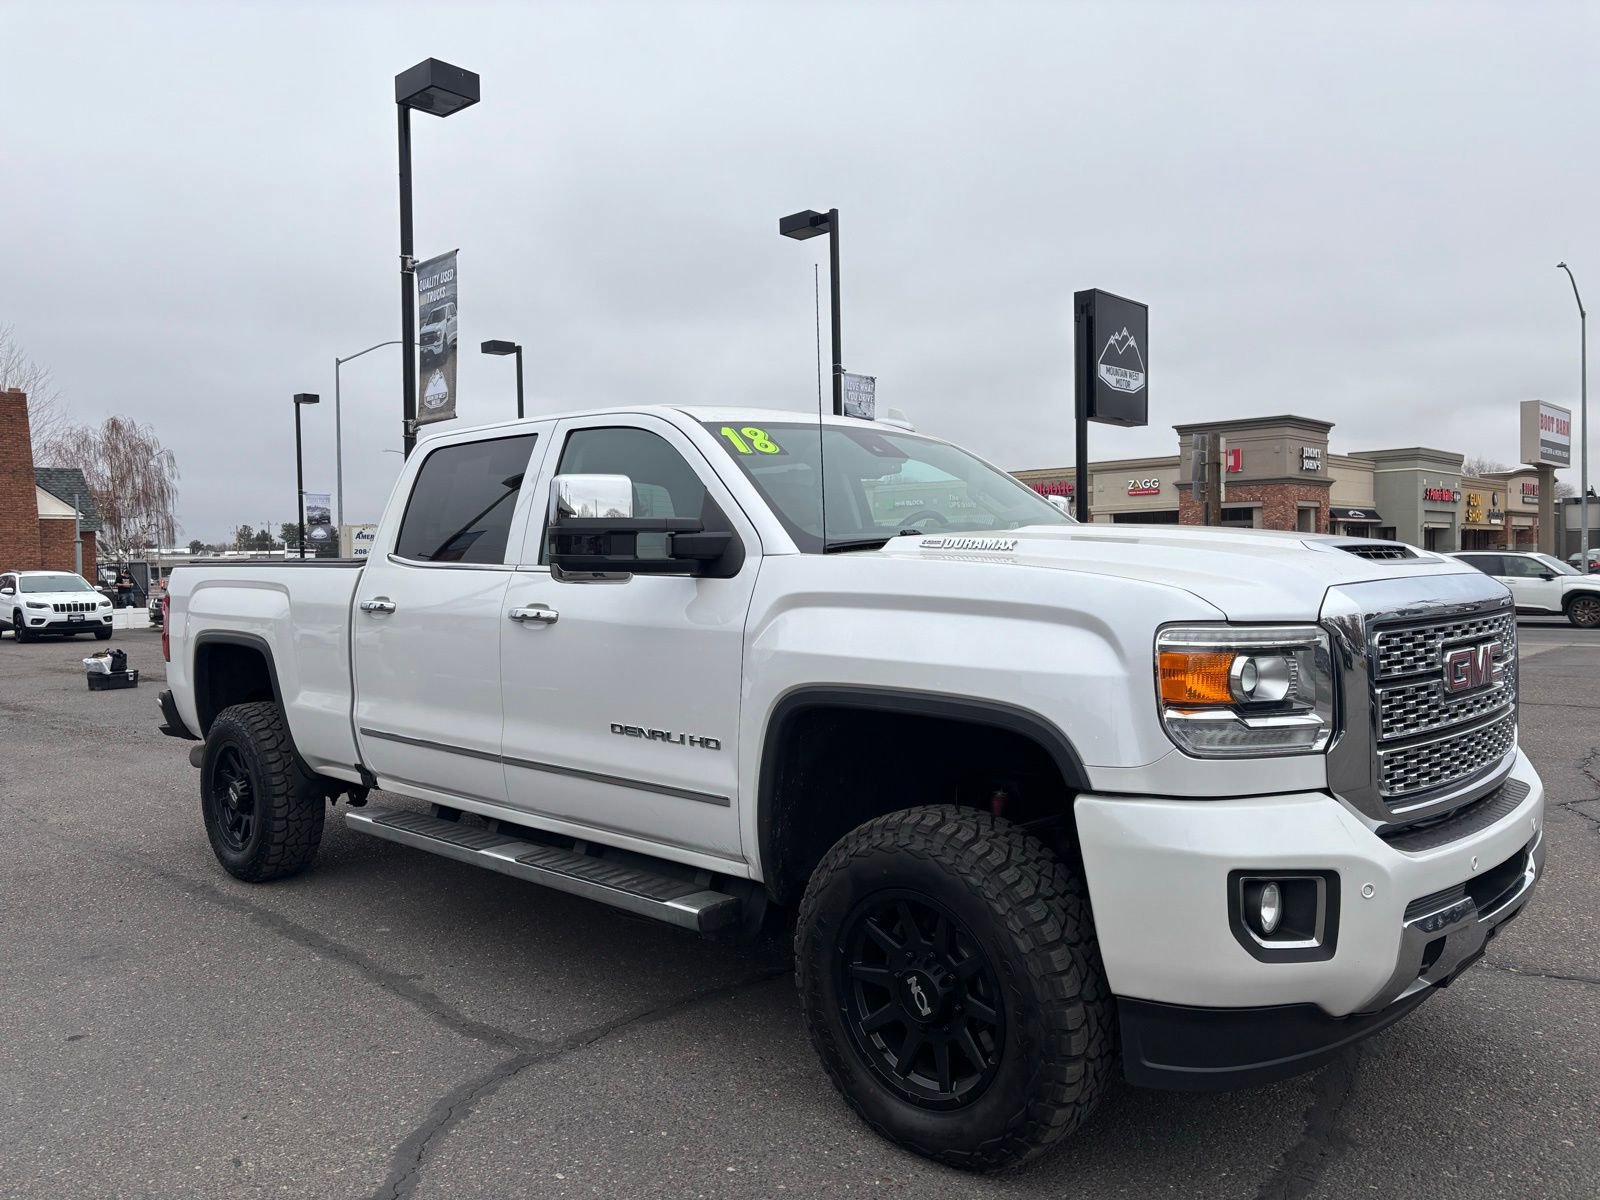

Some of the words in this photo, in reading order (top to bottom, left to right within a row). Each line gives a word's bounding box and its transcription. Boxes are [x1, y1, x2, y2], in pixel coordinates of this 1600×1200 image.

[419, 273, 440, 291] QUALITY
[440, 268, 454, 283] USED
[427, 286, 446, 303] TRUCKS
[1106, 366, 1128, 378] MOUNTAIN
[1129, 372, 1139, 381] WEST
[1115, 377, 1131, 388] MOTOR
[1540, 413, 1554, 432] BOOT
[1556, 418, 1569, 436] BARN
[720, 426, 780, 454] 18
[1302, 447, 1321, 458] JIMMY
[1302, 459, 1321, 470] JOHN'S
[1128, 478, 1160, 489] ZAGG
[1469, 493, 1481, 507] GUN
[1468, 508, 1482, 522] SHOP
[943, 538, 1018, 551] DURAMAX
[1443, 641, 1503, 693] GMC
[610, 723, 686, 746] DENALI
[689, 735, 721, 750] HD
